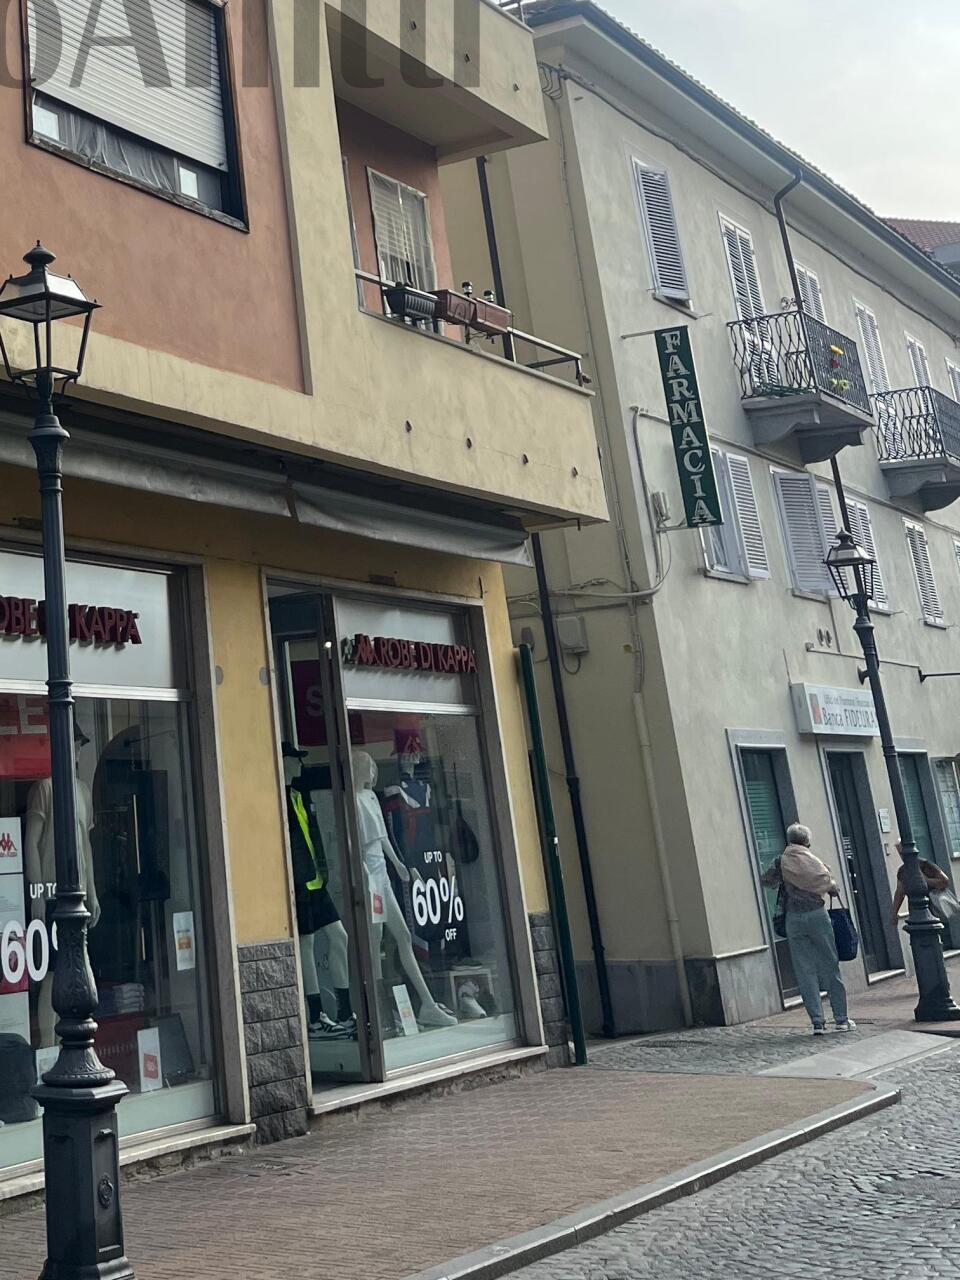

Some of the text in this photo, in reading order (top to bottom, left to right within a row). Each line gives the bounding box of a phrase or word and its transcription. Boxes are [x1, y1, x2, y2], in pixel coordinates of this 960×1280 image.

[661, 330, 717, 522] FARMACIA
[68, 603, 143, 645] KAPPA
[376, 637, 477, 673] ROBE DI KAPPA
[822, 706, 879, 729] Banca FIDEURA
[423, 850, 443, 864] UP TO
[30, 883, 45, 899] UP
[412, 875, 464, 926] 60%
[1, 919, 59, 984] 60
[445, 928, 457, 941] OFF
